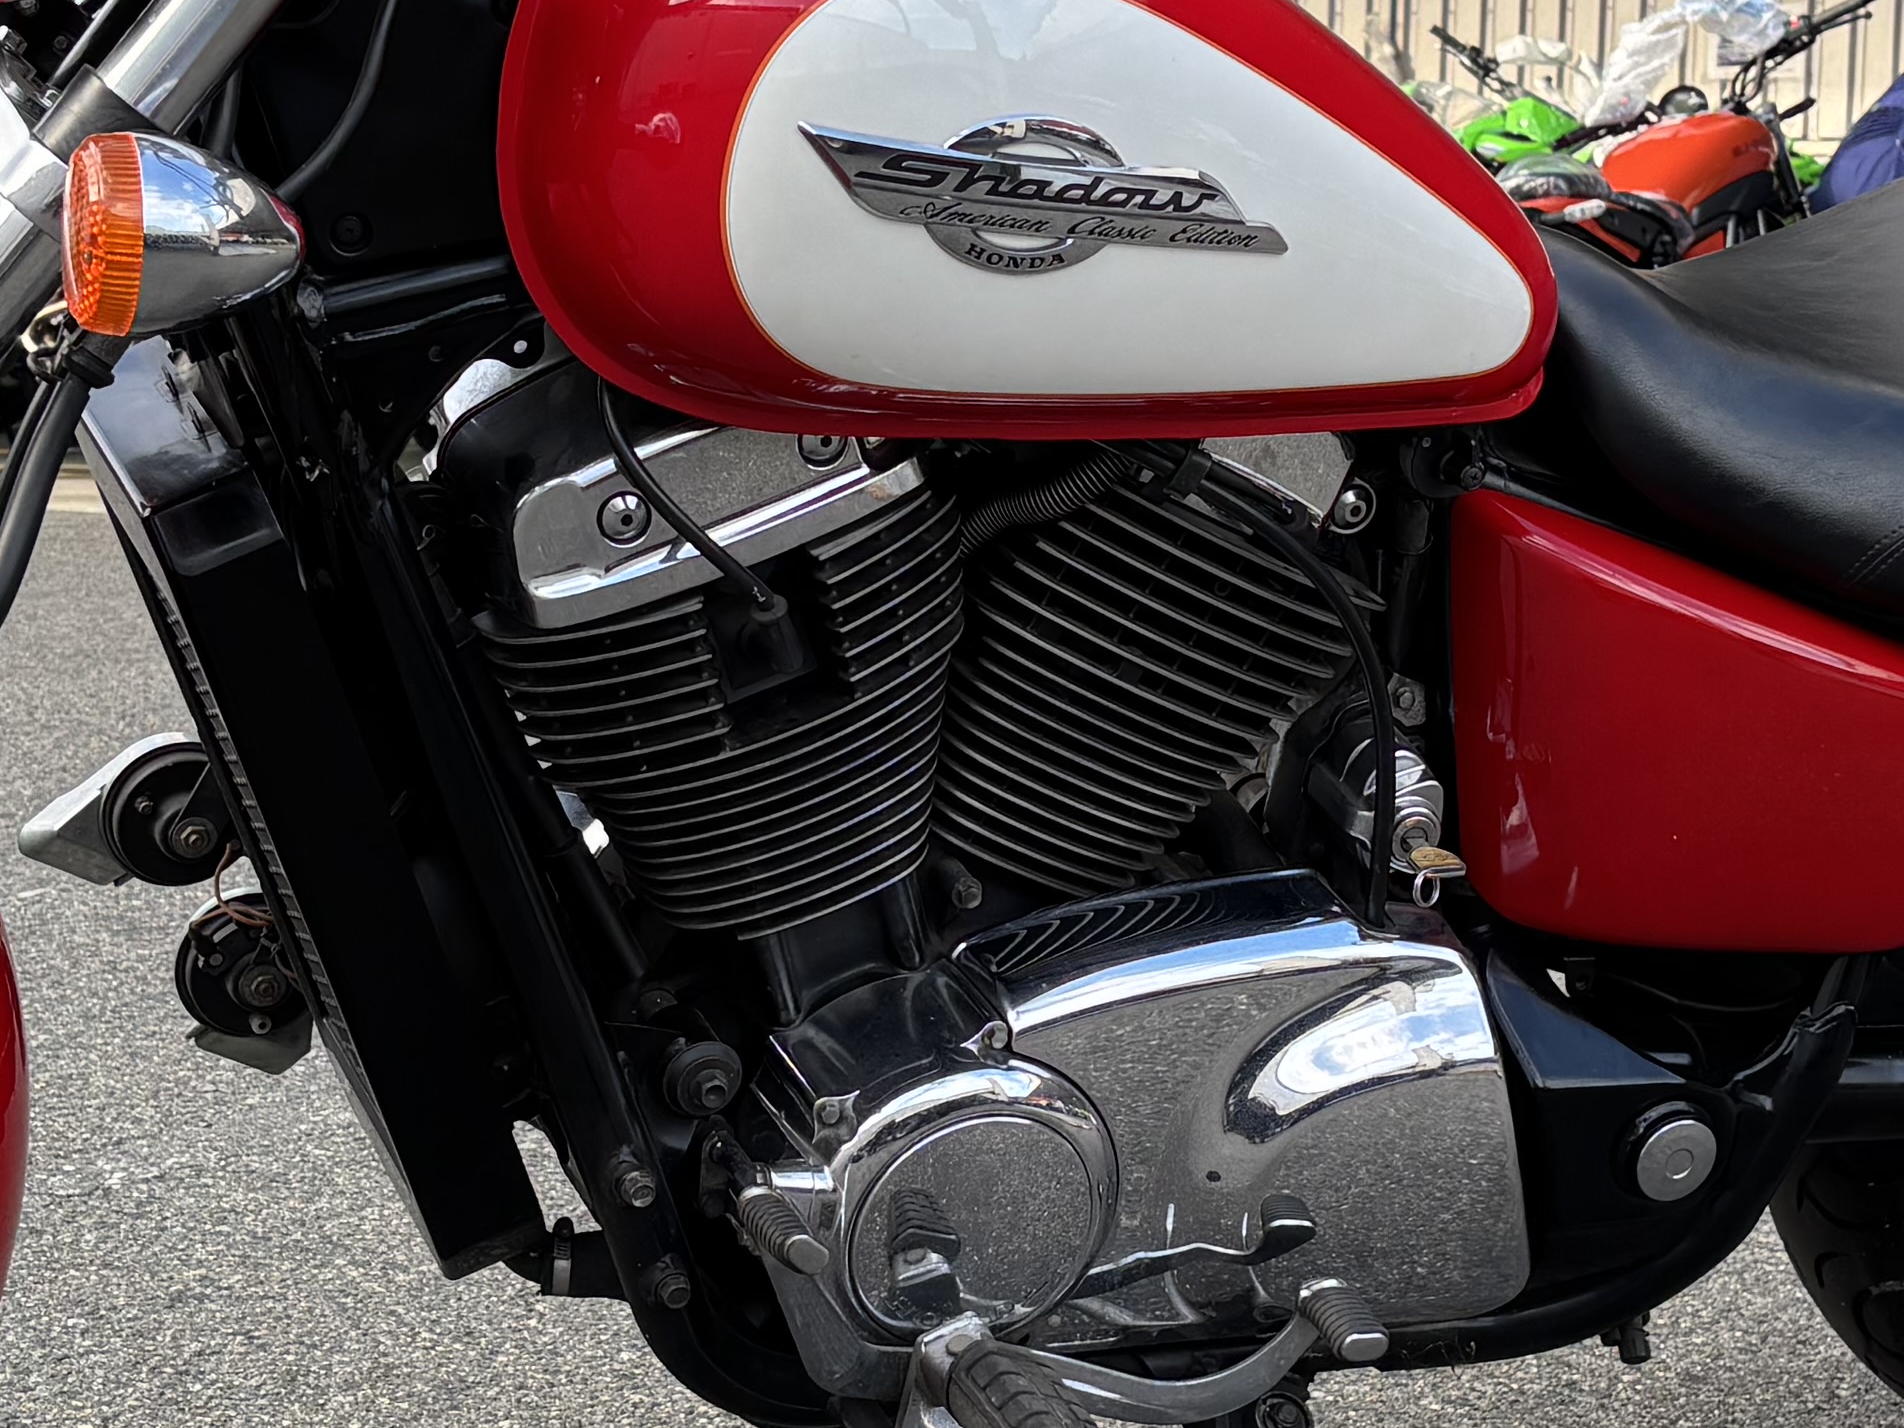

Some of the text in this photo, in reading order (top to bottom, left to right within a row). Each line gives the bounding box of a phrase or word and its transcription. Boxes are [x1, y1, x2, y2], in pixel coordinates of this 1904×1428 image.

[853, 153, 1220, 213] Shadow
[899, 202, 1261, 249] American Classic Edition
[965, 243, 1066, 269] HONDA
